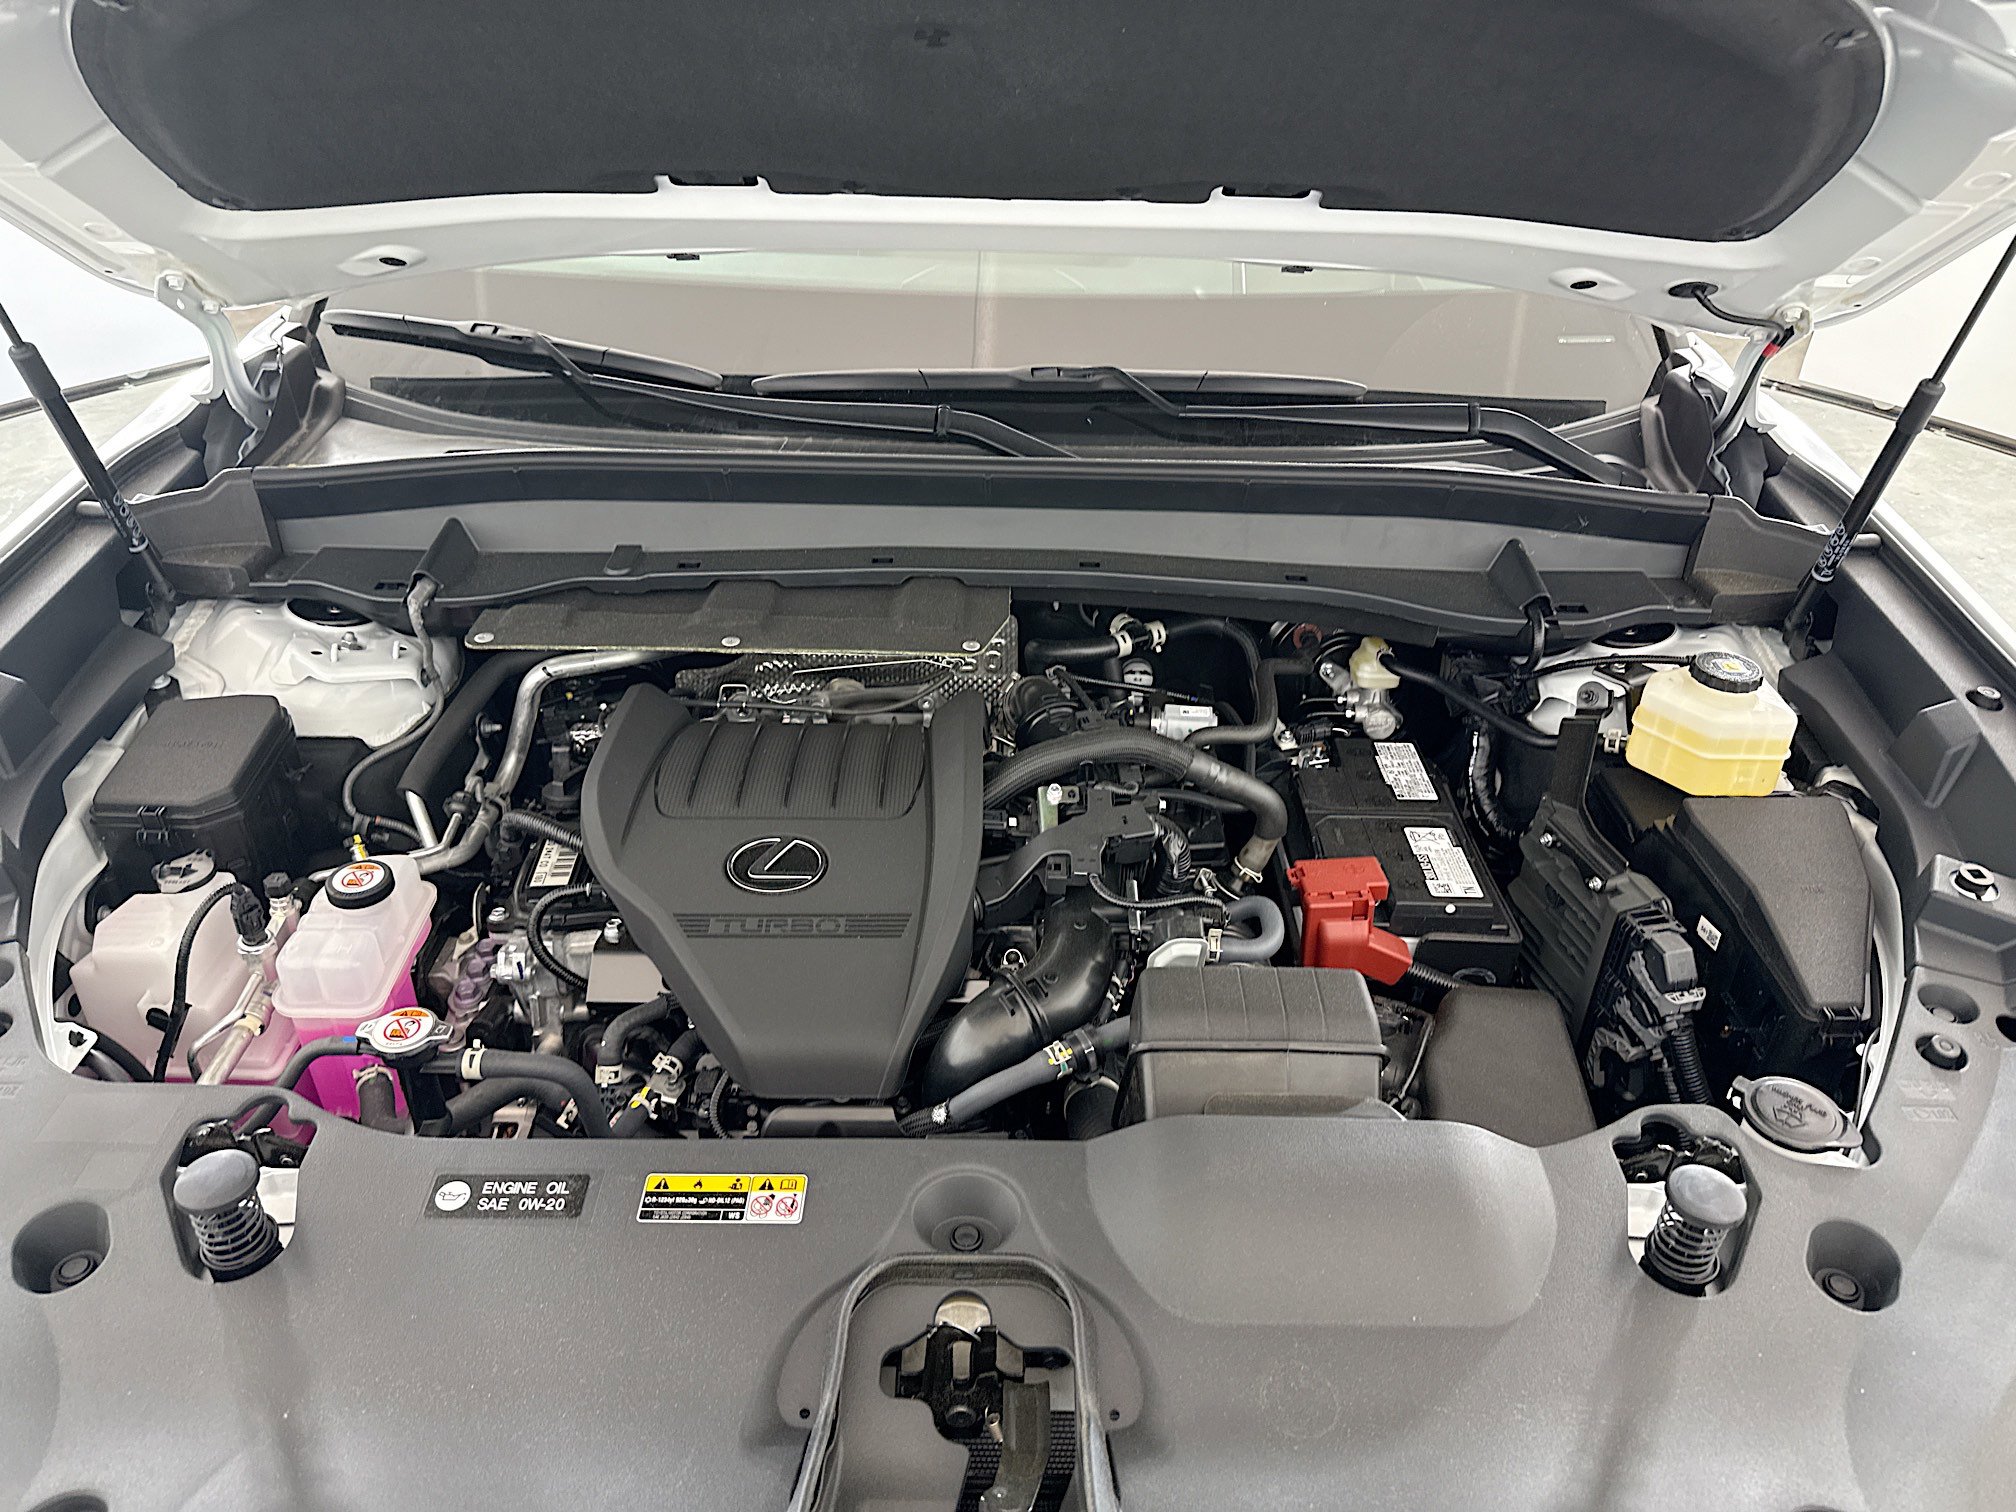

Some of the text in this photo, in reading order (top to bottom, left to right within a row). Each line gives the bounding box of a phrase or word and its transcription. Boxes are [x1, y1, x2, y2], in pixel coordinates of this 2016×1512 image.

[713, 917, 843, 934] TURBO
[481, 1181, 570, 1195] ENGINE OIL
[476, 1197, 566, 1211] SAE 0W-20
[728, 1211, 741, 1220] WS
